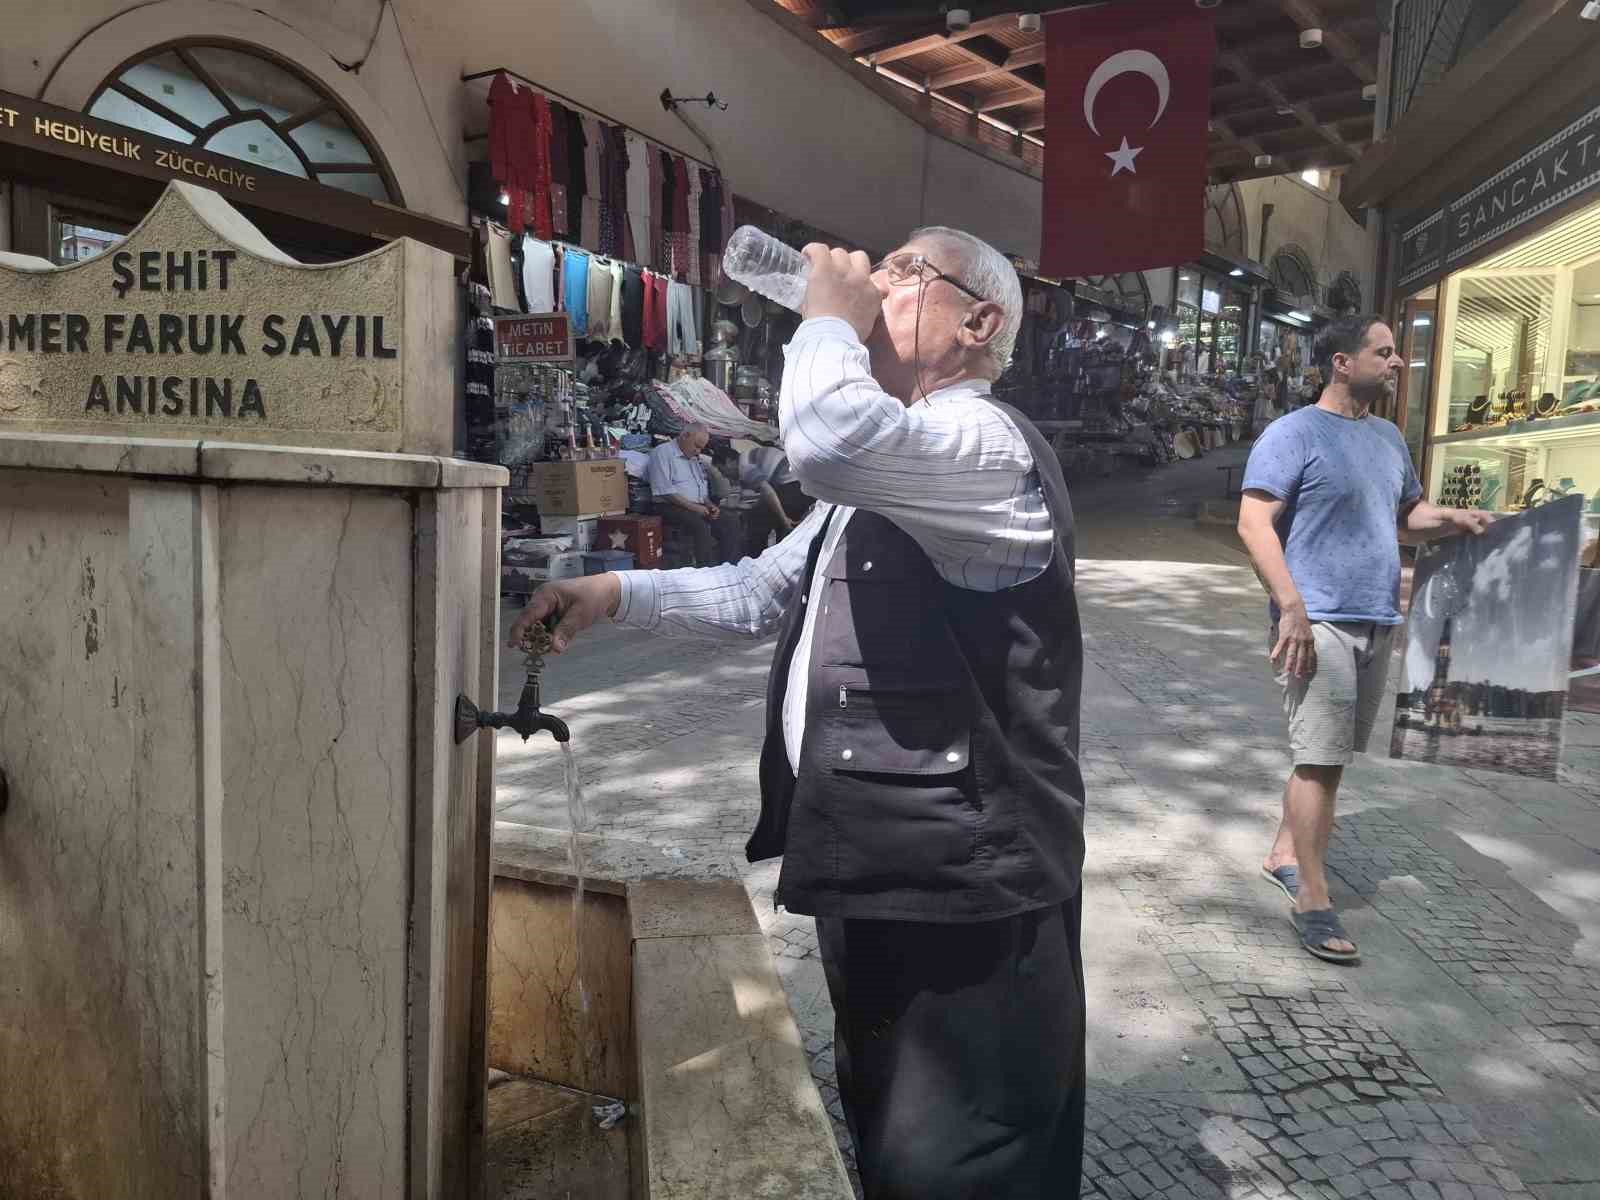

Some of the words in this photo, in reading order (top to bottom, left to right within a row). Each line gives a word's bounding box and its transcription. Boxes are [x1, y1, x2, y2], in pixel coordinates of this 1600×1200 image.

[34, 116, 141, 161] HEDİYELİK
[154, 149, 256, 192] ZÜCCACİYE
[1458, 134, 1600, 239] SANCAKT
[112, 249, 237, 298] ŞEHİT
[0, 313, 89, 352] MER
[104, 313, 246, 354] FARUK
[262, 315, 397, 358] SAYIL
[85, 374, 266, 418] ANISINA
